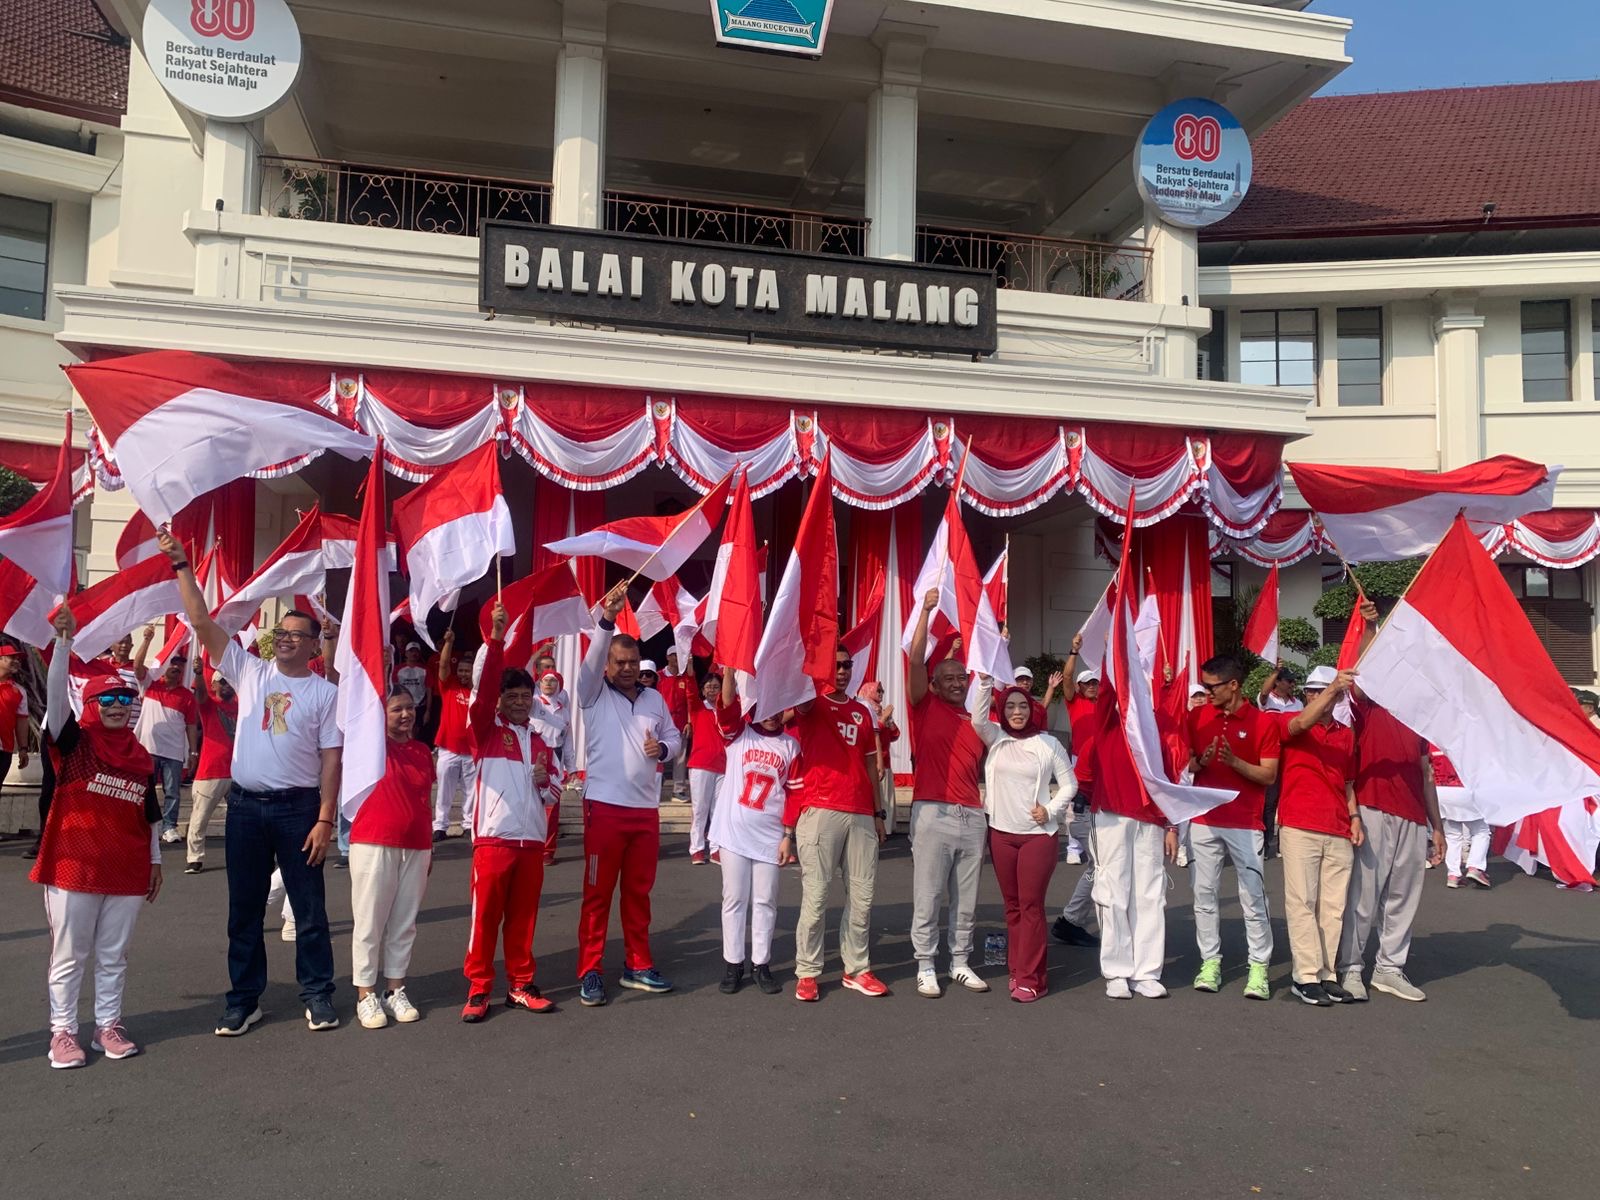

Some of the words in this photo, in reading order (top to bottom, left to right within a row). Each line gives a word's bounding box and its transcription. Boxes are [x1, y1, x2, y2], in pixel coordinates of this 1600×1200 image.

[190, 0, 255, 41] 80
[731, 18, 762, 29] MALANG
[165, 41, 213, 57] Bersatu
[216, 47, 276, 66] Berdaulat
[165, 56, 207, 70] Rakyat
[210, 60, 268, 77] Sejahtera
[165, 67, 224, 85] Indonesia
[227, 75, 258, 91] Maju
[1173, 113, 1222, 163] 80
[1156, 163, 1191, 177] Bersatu
[1192, 167, 1235, 181] Berdaulat
[1156, 175, 1186, 187] Rakyat
[1187, 178, 1229, 191] Sejahtera
[1155, 186, 1198, 200] Indonesia
[1199, 190, 1222, 203] Maju
[504, 244, 643, 297] BALAI
[671, 260, 780, 310] KOTA
[805, 274, 979, 327] MALANG
[738, 770, 776, 812] 17
